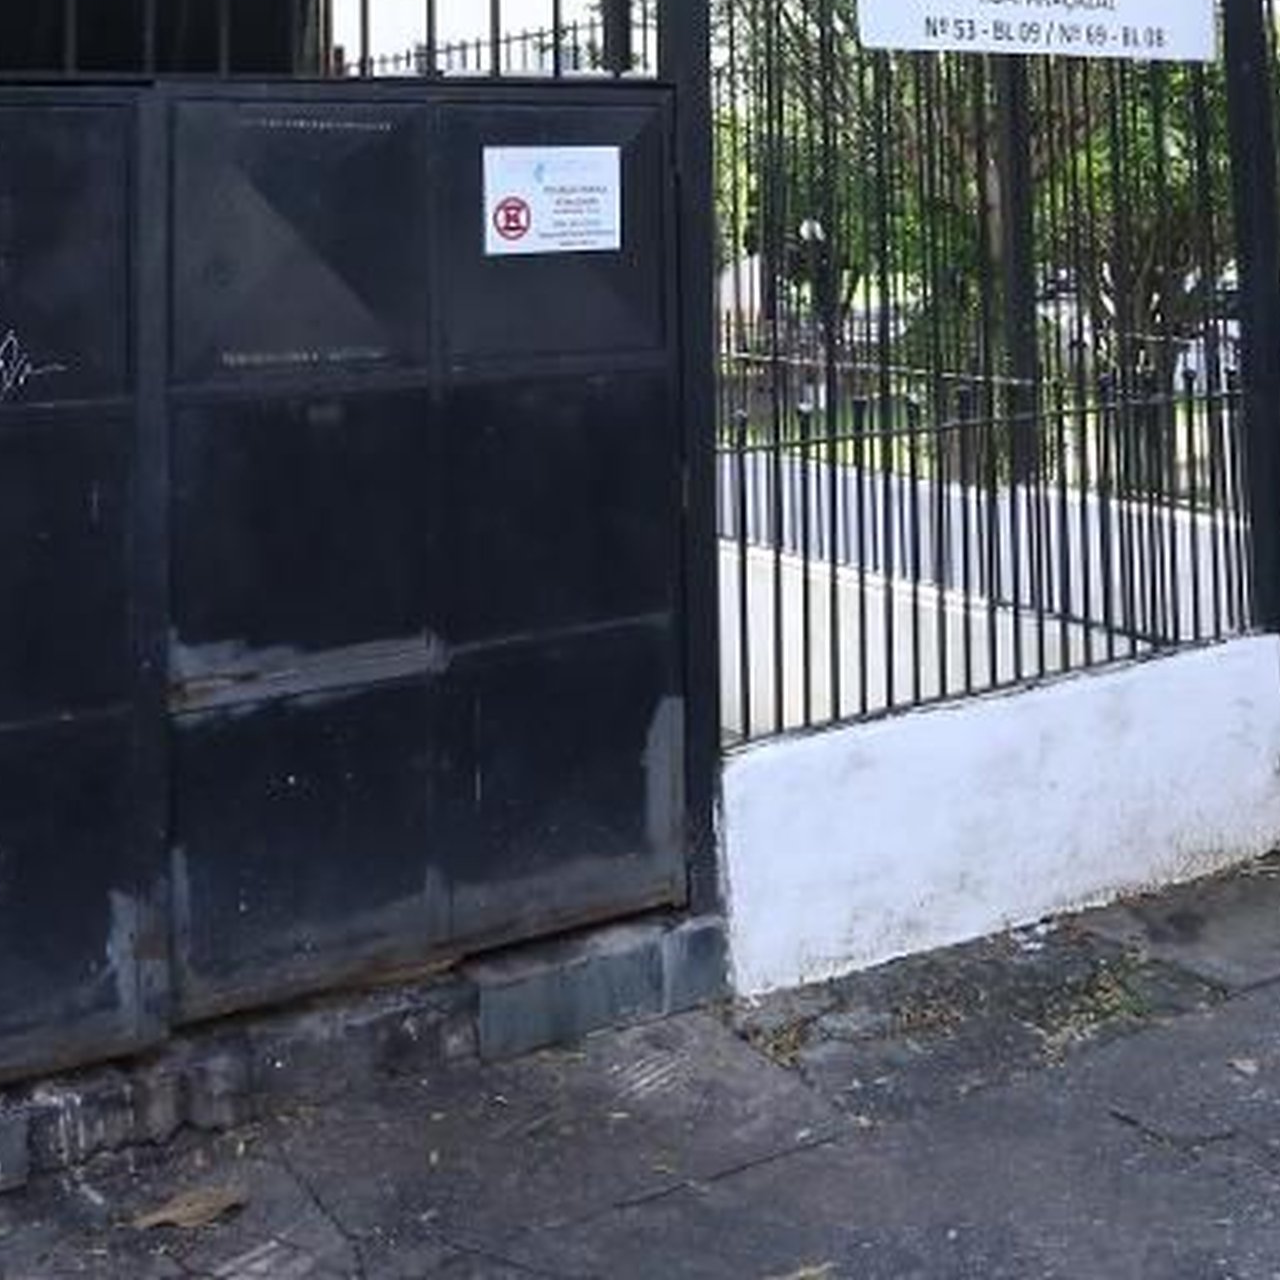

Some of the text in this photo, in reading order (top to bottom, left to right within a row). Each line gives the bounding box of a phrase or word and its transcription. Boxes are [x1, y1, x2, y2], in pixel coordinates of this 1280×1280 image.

[953, 18, 976, 40] 53
[992, 19, 1015, 42] BL
[1019, 21, 1041, 44] 09
